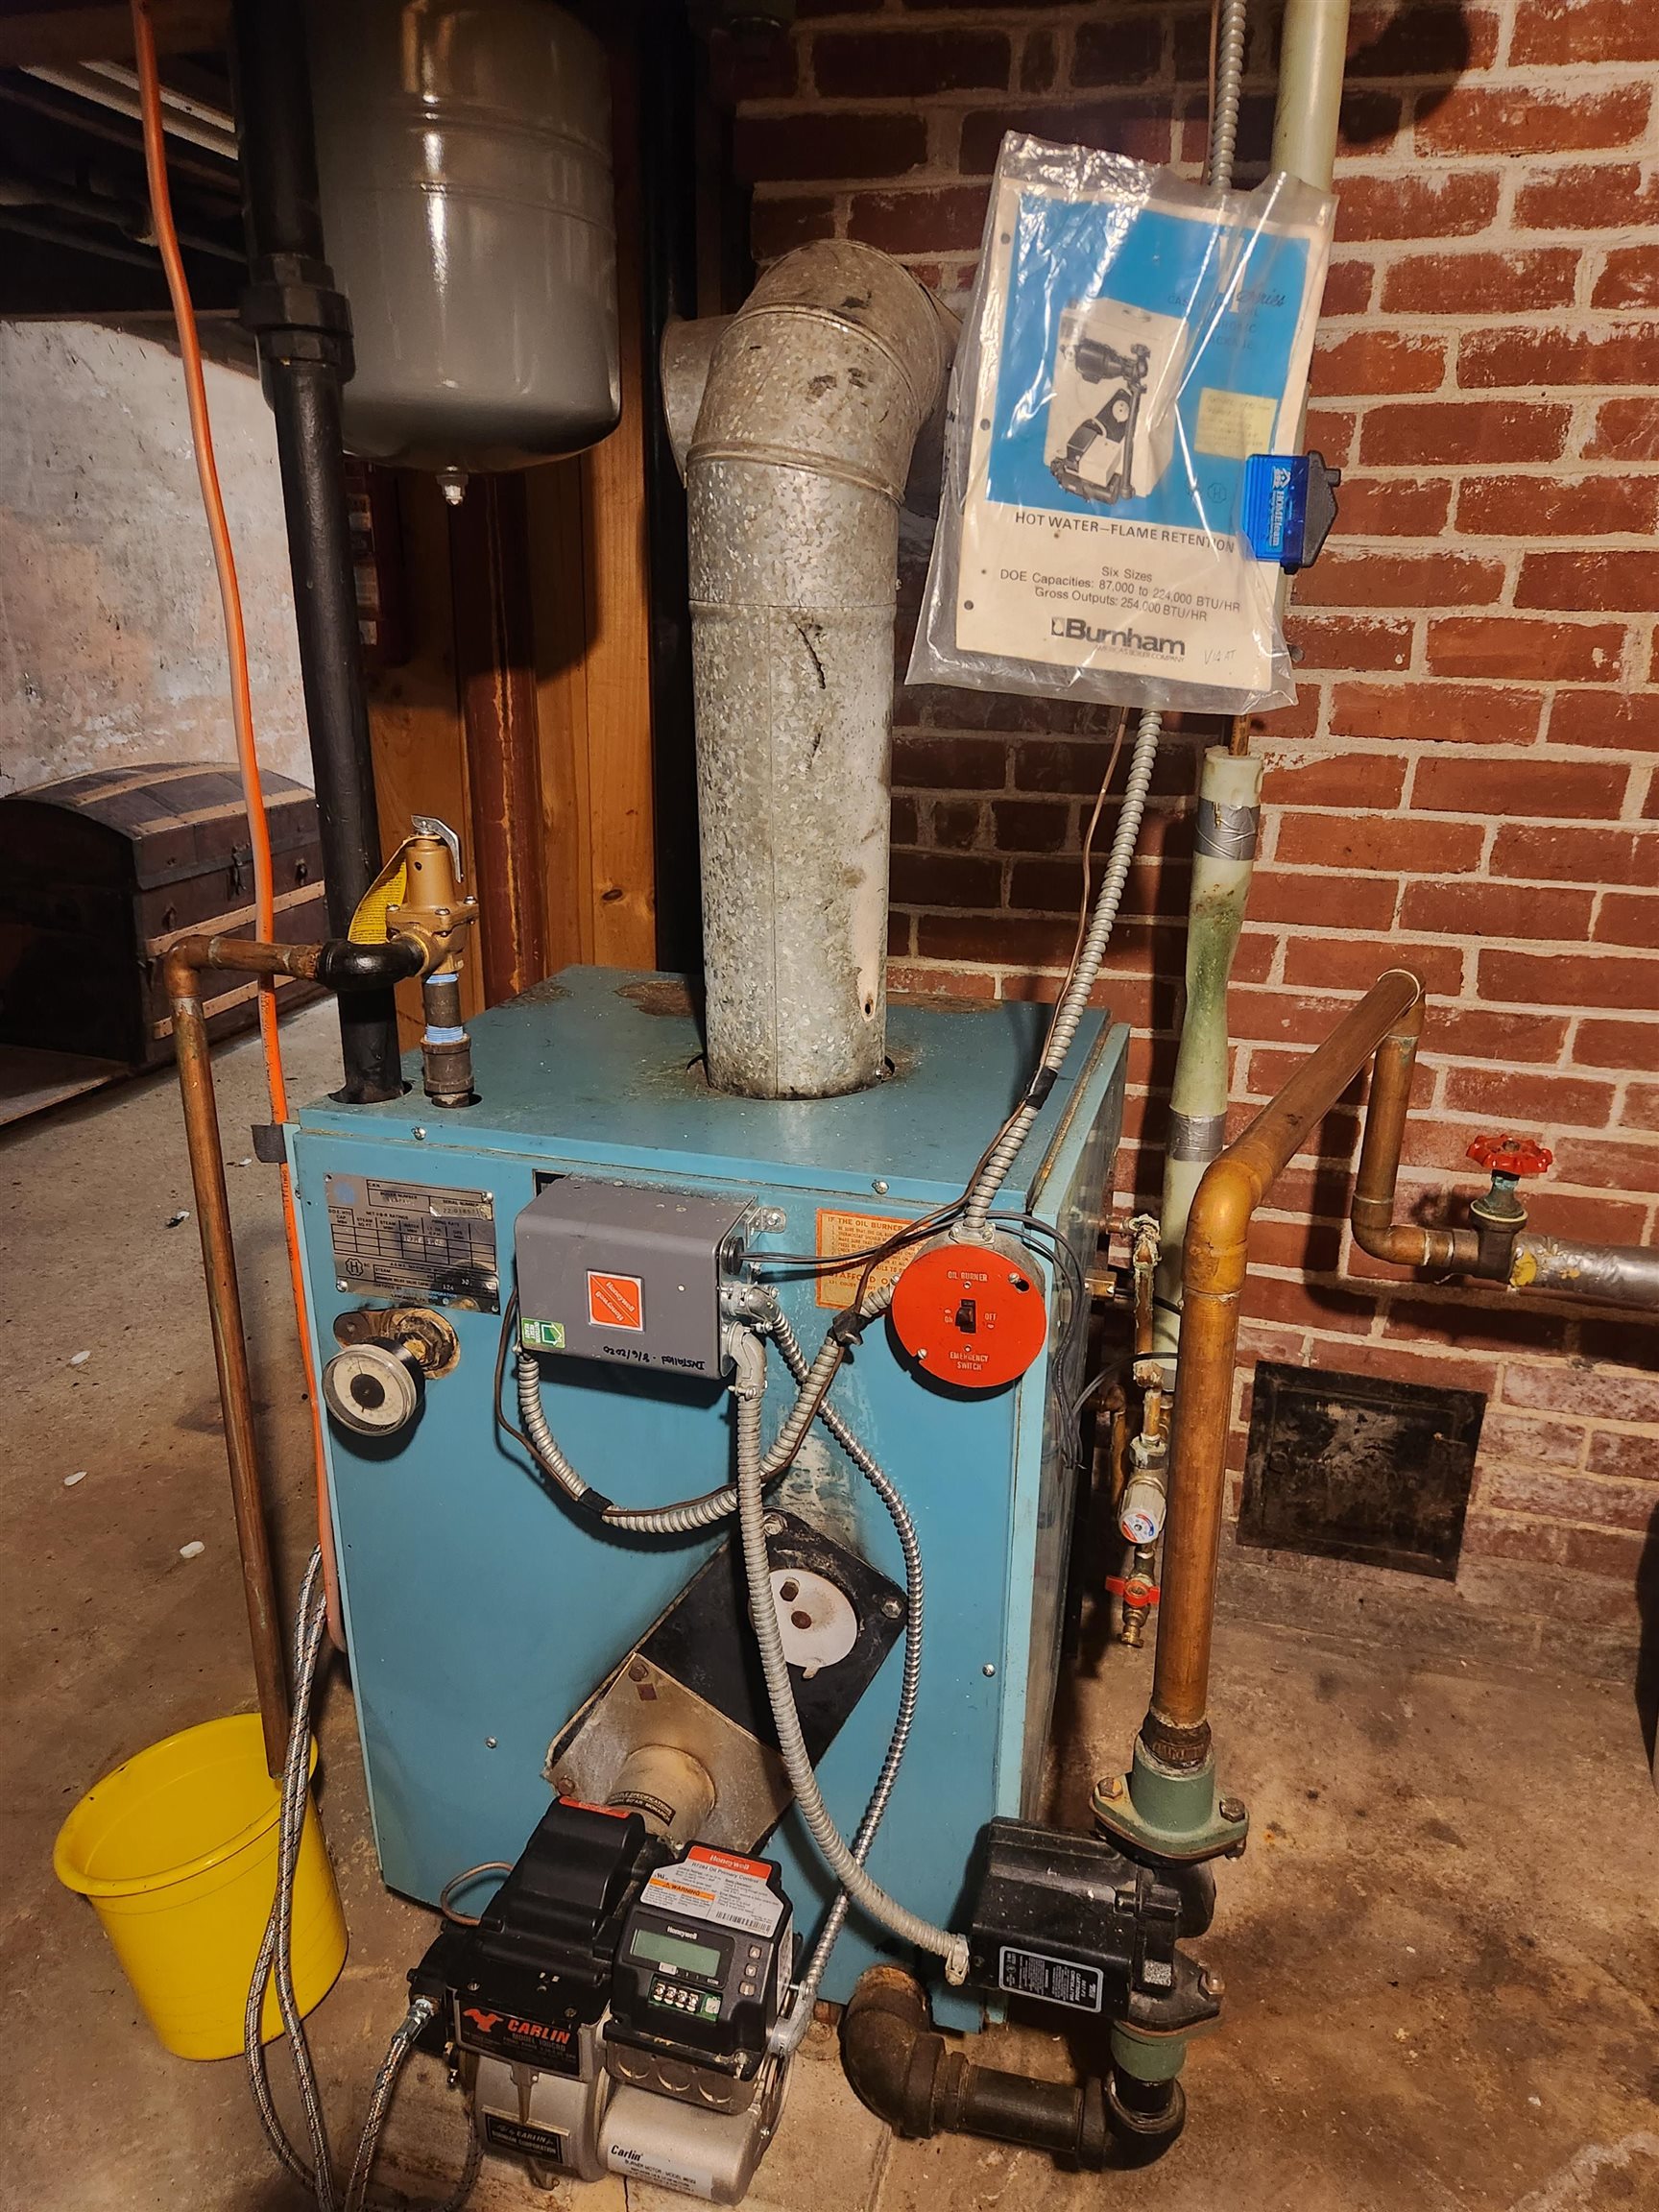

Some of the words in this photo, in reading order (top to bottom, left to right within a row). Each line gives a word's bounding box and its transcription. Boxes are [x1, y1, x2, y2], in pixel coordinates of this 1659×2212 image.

[1015, 512, 1045, 526] HOT
[1161, 532, 1236, 553] RETENTION
[1101, 565, 1119, 578] Six
[1123, 568, 1152, 583] Sizes
[1000, 568, 1027, 582] DOE
[1032, 572, 1094, 589] Capacities:
[1139, 585, 1149, 596] to
[1196, 595, 1240, 613] BTU/HR
[1034, 587, 1069, 599] Gross
[1071, 591, 1118, 607] Outputs:
[1163, 603, 1208, 622] BTU/HR
[1066, 617, 1186, 656] Burnham
[838, 1217, 853, 1226] THE
[960, 1272, 988, 1282] BURNER
[606, 1281, 636, 1312] Honeywell
[984, 1312, 997, 1321] OFF
[603, 1345, 651, 1363] 8/6/2020
[950, 1351, 989, 1362] EMERGENCY
[957, 1361, 982, 1371] SWITCH
[709, 1854, 751, 1871] Honeywell
[717, 1867, 738, 1879] Primary
[738, 1873, 759, 1884] Control
[671, 1884, 701, 1896] WARNING
[666, 1925, 698, 1939] Honeywell
[507, 2018, 570, 2044] CARLIN
[611, 2144, 641, 2162] Carlin
